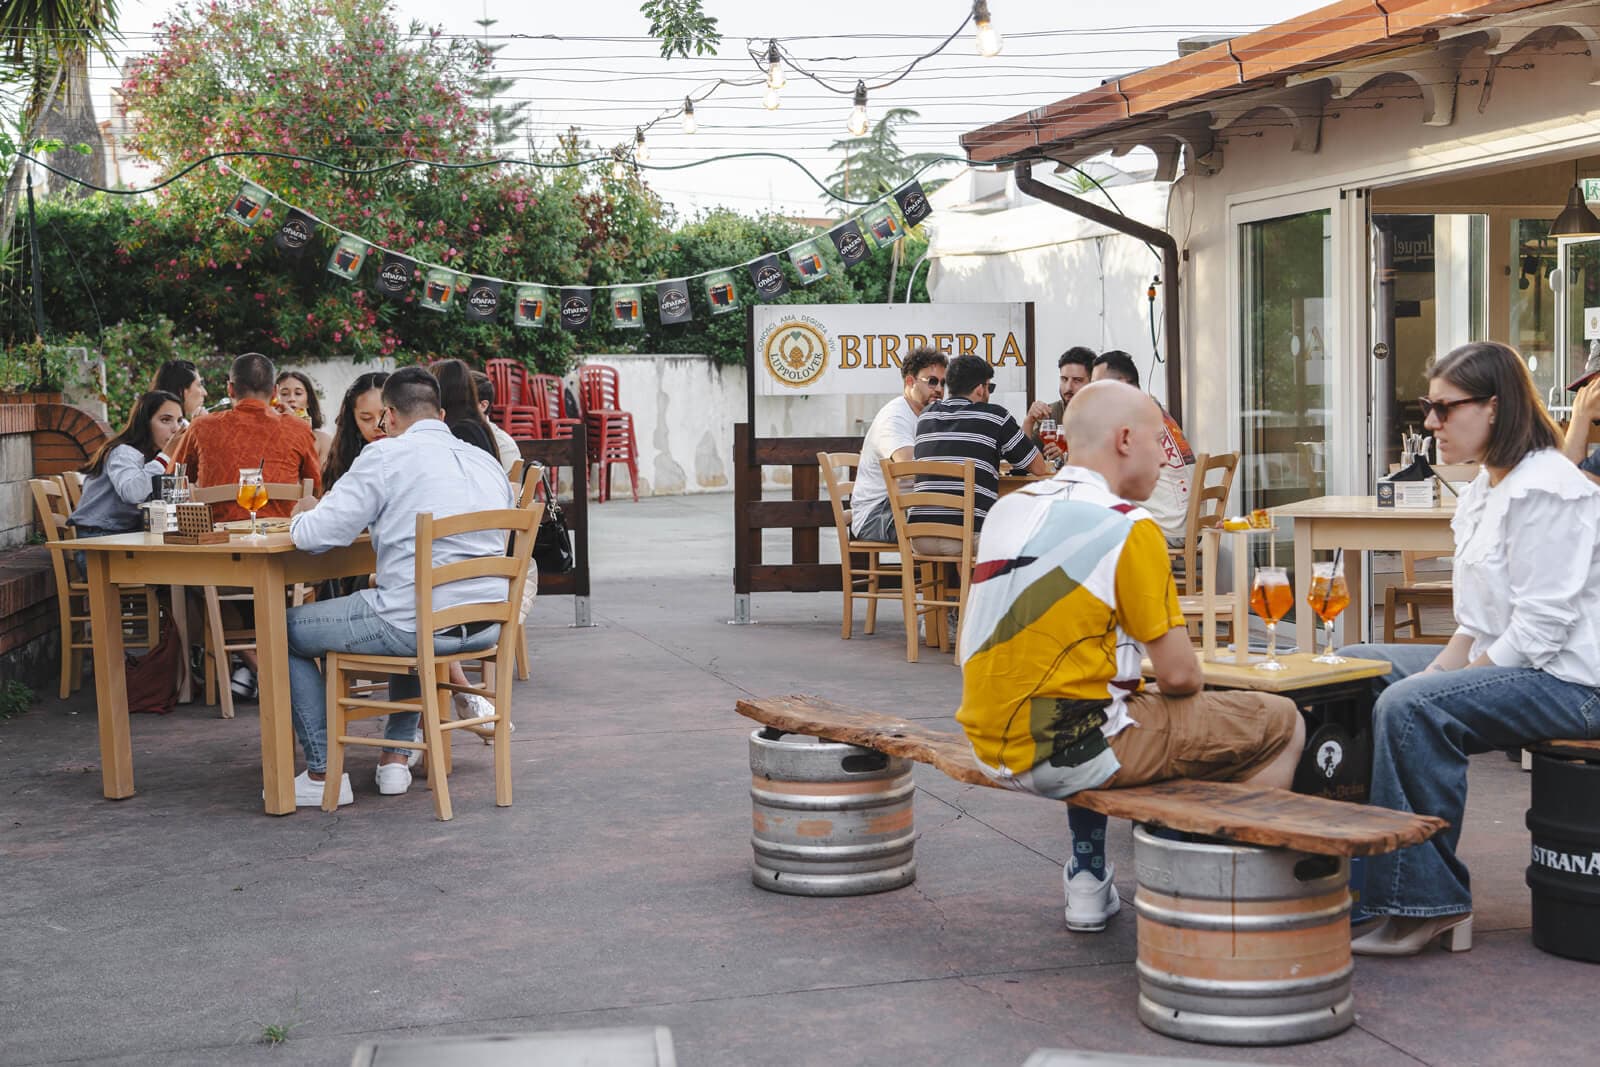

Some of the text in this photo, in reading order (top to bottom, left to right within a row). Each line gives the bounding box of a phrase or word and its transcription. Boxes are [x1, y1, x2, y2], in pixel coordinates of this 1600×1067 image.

[757, 322, 777, 353] CONOSCI
[780, 314, 796, 324] AMA
[801, 315, 828, 335] DEGUSTA
[770, 352, 823, 380] LUPPOLOVER
